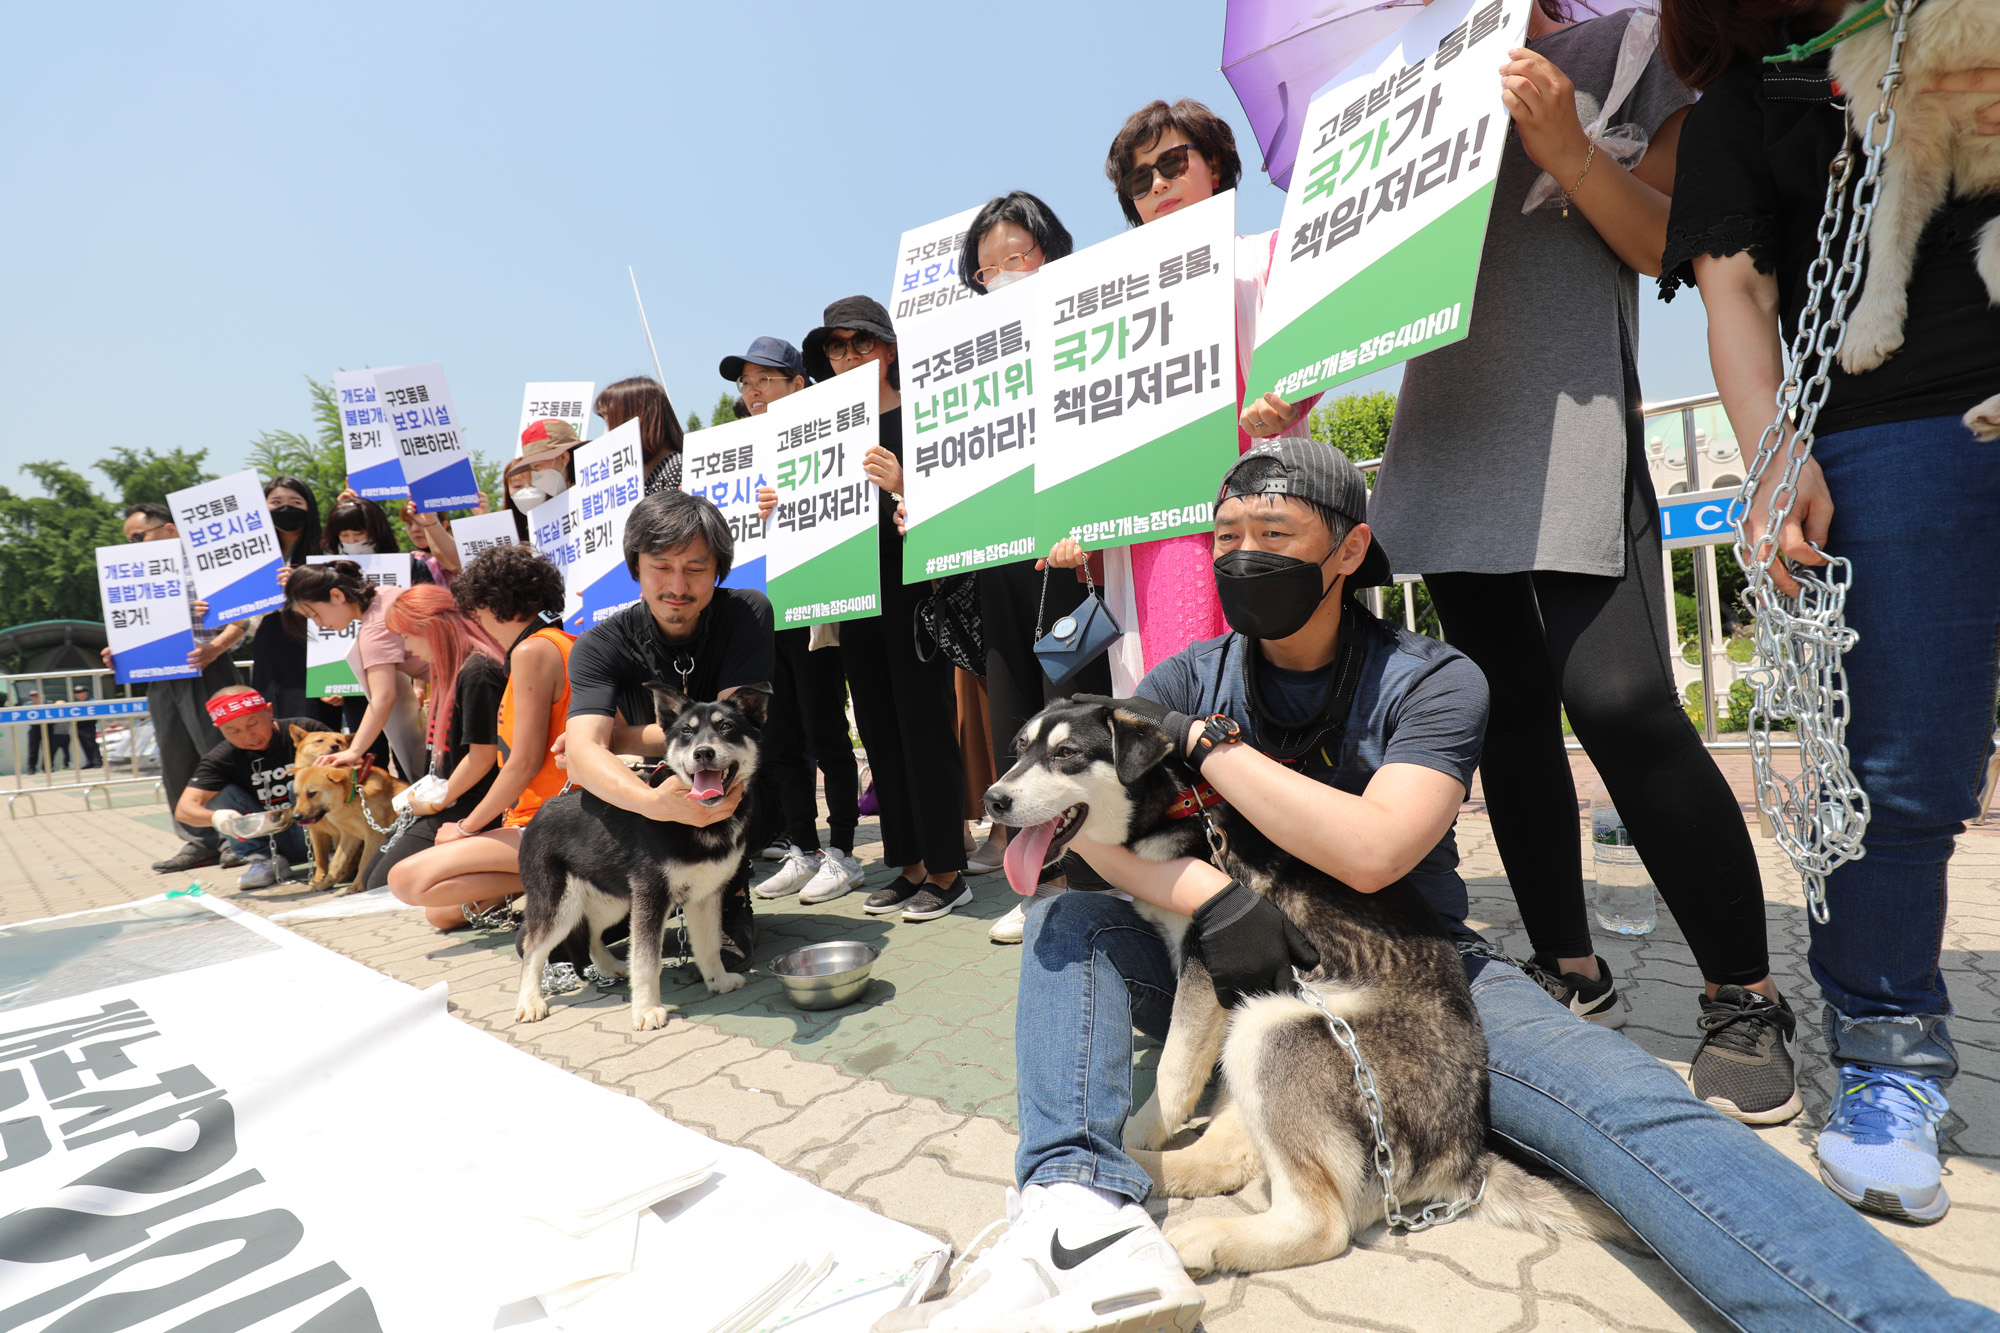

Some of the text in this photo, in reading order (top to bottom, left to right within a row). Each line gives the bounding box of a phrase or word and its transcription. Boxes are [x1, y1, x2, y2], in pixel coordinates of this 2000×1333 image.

[1313, 0, 1510, 154] 고통받는 동물,
[1302, 82, 1442, 204] 국가가
[1290, 113, 1490, 262] 책임져라!
[902, 258, 962, 293] 보호시
[1054, 244, 1220, 326] 고통받는 동물,
[896, 283, 981, 320] 마련하라
[912, 320, 1031, 388] 구조동물들,
[1054, 301, 1173, 372] 국가가
[1272, 302, 1461, 397] #양산개농장64아이
[341, 387, 376, 403] 개도살
[385, 385, 429, 407] 구호동물
[914, 359, 1033, 434] 난민지위
[1054, 343, 1220, 426] 책임져라!
[392, 405, 451, 431] 보호시설
[528, 401, 584, 419] 구조동물들,
[777, 402, 870, 452] 고통받는 동물,
[349, 430, 381, 450] 철거!
[400, 431, 460, 456] 마련하라!
[915, 408, 1035, 477] 부여하라!
[580, 444, 637, 487] 개도살 금지,
[691, 444, 753, 479] 구호동물
[777, 442, 845, 491] 국가가
[181, 495, 239, 524] 구호동물
[582, 475, 638, 520] 불법개농장
[777, 479, 870, 532] 책임져라!
[189, 510, 263, 548] 보호시설
[533, 519, 560, 547] 개도살
[584, 520, 612, 554] 철거!
[1069, 501, 1214, 543] #양산개농장64아
[104, 558, 179, 580] 개도살 금지,
[197, 534, 272, 571] 마련하라!
[926, 537, 1035, 574] #양산개농장64아
[107, 579, 181, 604] 불법개농장
[785, 594, 876, 622] #양산개농장64아이
[112, 607, 150, 628] 철거!
[12, 702, 143, 721] POLICE LIN
